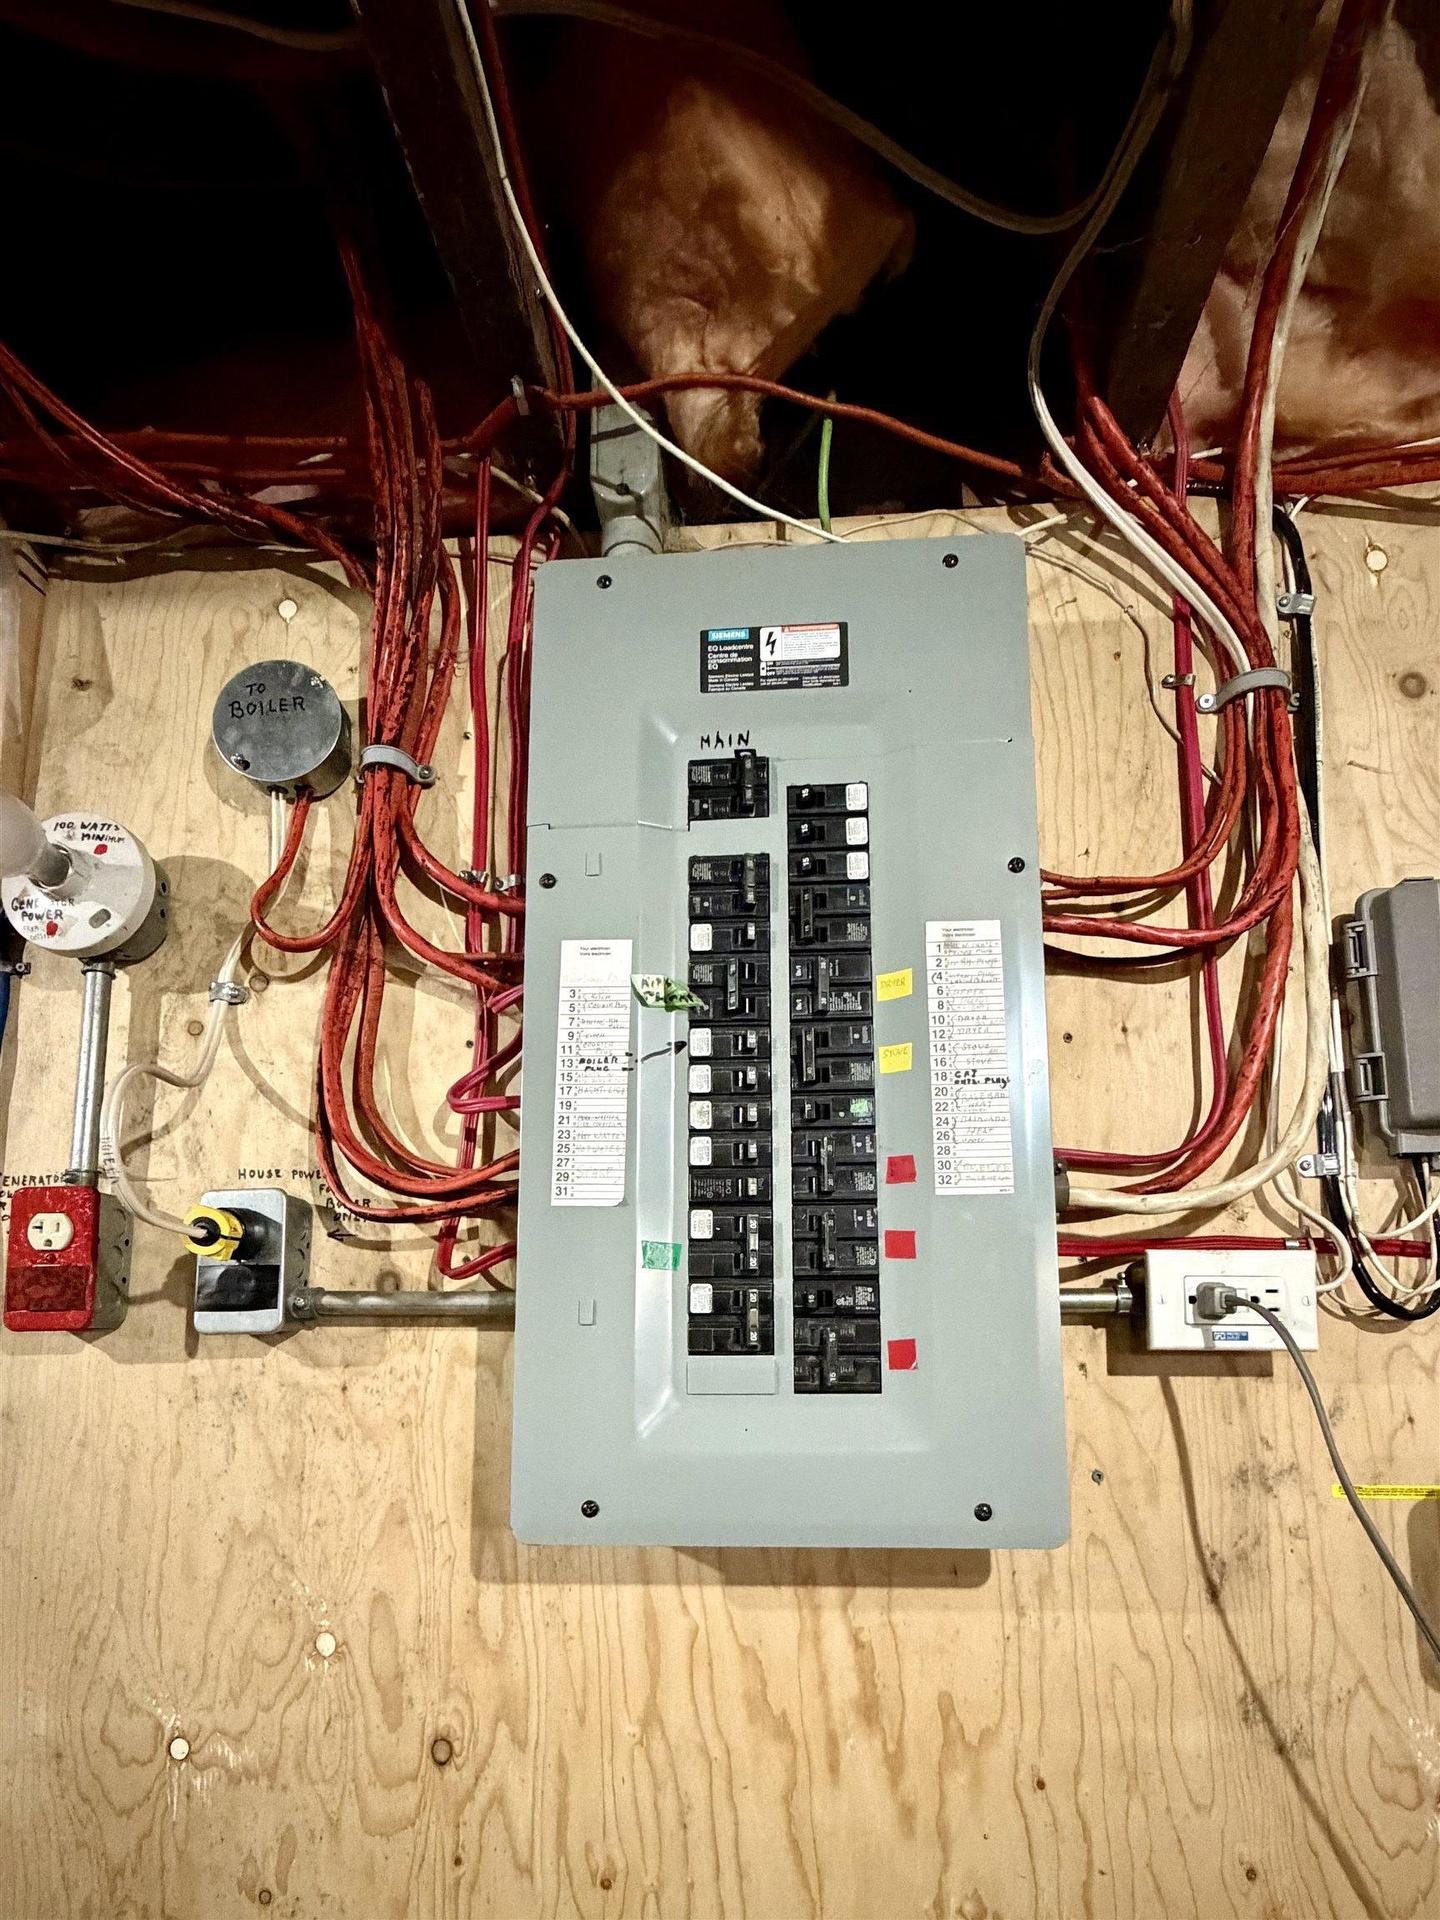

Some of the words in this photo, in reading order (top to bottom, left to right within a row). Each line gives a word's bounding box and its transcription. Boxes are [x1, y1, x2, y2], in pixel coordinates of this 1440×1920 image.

[711, 631, 746, 639] SIEMENS
[246, 682, 265, 694] TO
[229, 696, 305, 719] BOILER
[700, 730, 750, 749] MAIN
[802, 788, 809, 798] 15
[54, 821, 75, 831] 100
[801, 824, 808, 833] 15
[802, 857, 809, 866] 15
[21, 909, 64, 921] POWER
[936, 944, 941, 953] 1
[935, 958, 942, 967] 2
[936, 972, 943, 980] 4
[569, 989, 576, 998] 3
[937, 986, 944, 995] 6
[569, 1003, 575, 1012] 5
[937, 1000, 944, 1010] 8
[568, 1017, 575, 1026] 7
[932, 1015, 945, 1025] 10
[568, 1031, 574, 1040] 9
[932, 1029, 946, 1039] 12
[561, 1045, 572, 1054] 11
[933, 1043, 946, 1053] 14
[561, 1059, 573, 1068] 13
[579, 1055, 618, 1064] BOILER
[934, 1057, 947, 1067] 16
[561, 1072, 573, 1082] 15
[934, 1071, 947, 1081] 18
[560, 1086, 572, 1095] 17
[934, 1087, 948, 1096] 20
[559, 1100, 572, 1110] 19
[935, 1102, 949, 1111] 22
[558, 1115, 570, 1125] 21
[935, 1117, 949, 1126] 24
[557, 1130, 571, 1139] 23
[936, 1131, 950, 1140] 26
[557, 1143, 570, 1153] 25
[937, 1145, 951, 1155] 28
[556, 1158, 570, 1167] 27
[937, 1160, 951, 1170] 30
[238, 1169, 281, 1180] HOUSE
[292, 1169, 326, 1180] POWE
[556, 1172, 569, 1181] 29
[938, 1175, 952, 1185] 32
[555, 1186, 567, 1196] 31
